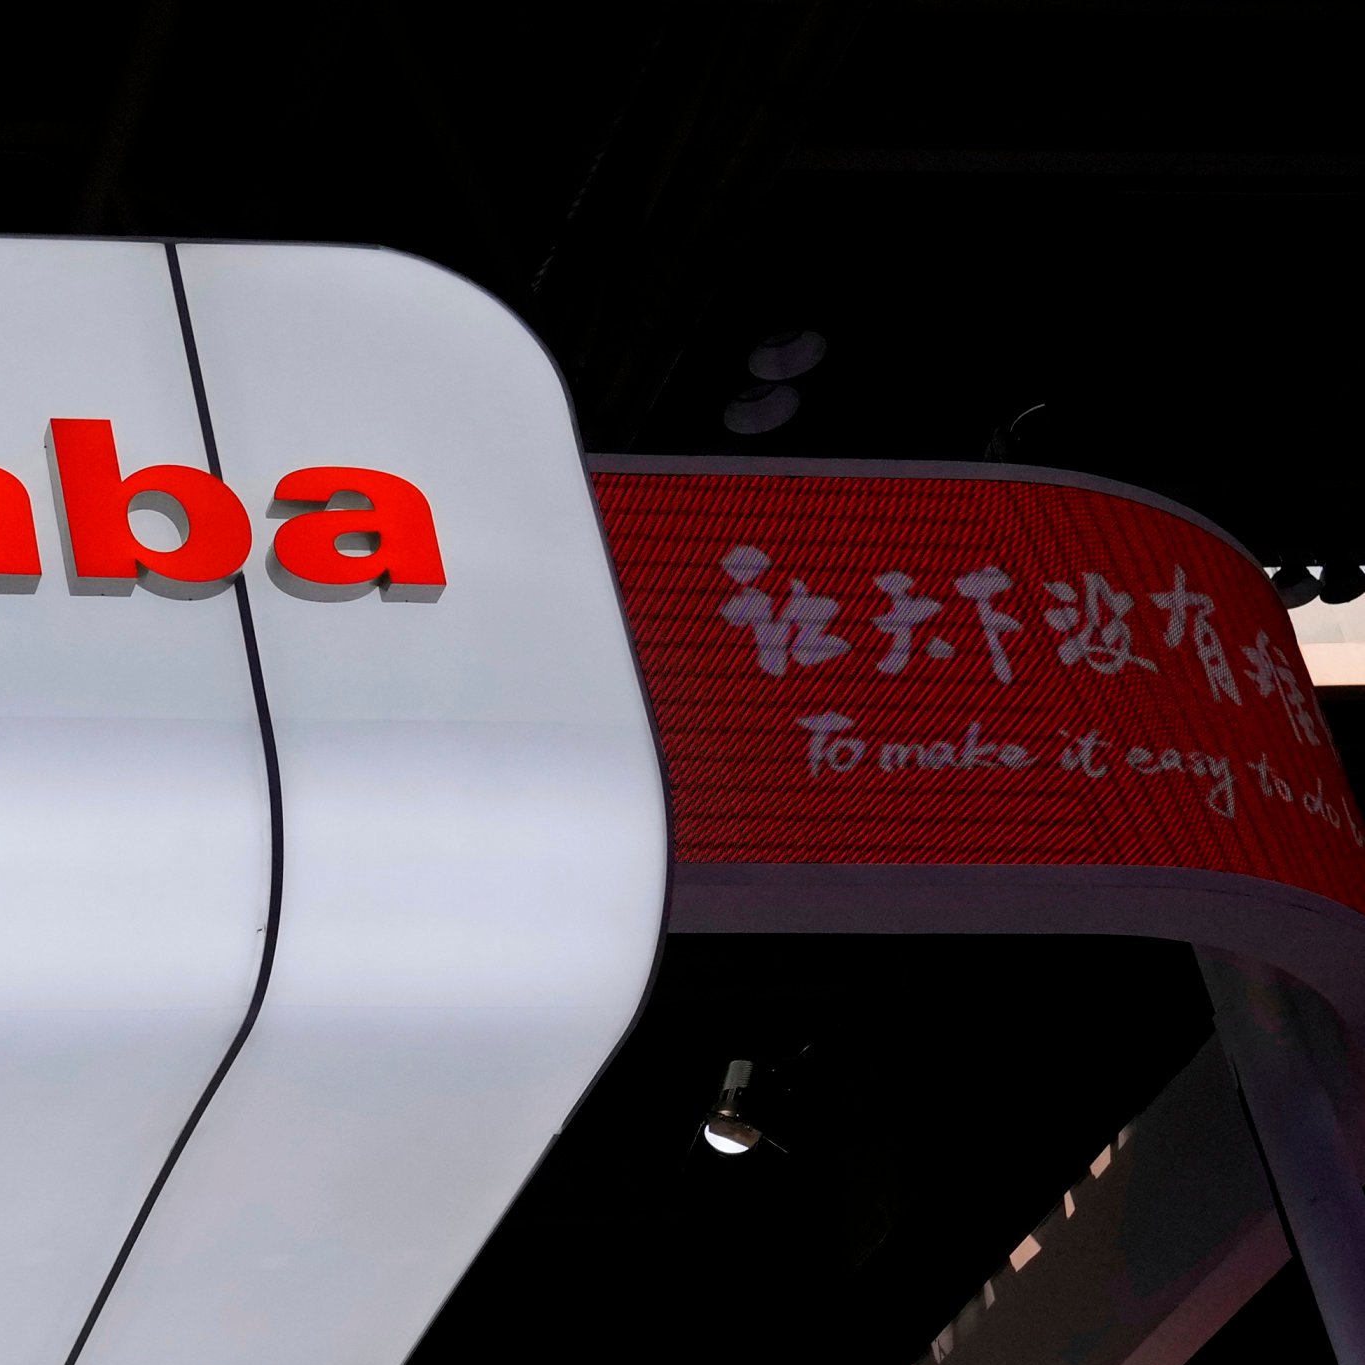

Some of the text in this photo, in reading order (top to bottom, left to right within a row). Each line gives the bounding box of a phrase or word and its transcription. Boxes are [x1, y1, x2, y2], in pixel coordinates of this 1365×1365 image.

[797, 710, 867, 779] To
[879, 720, 1041, 773] make
[1057, 729, 1112, 779] it
[1125, 746, 1236, 820] easy
[1245, 752, 1294, 802] to
[1302, 777, 1342, 829] do
